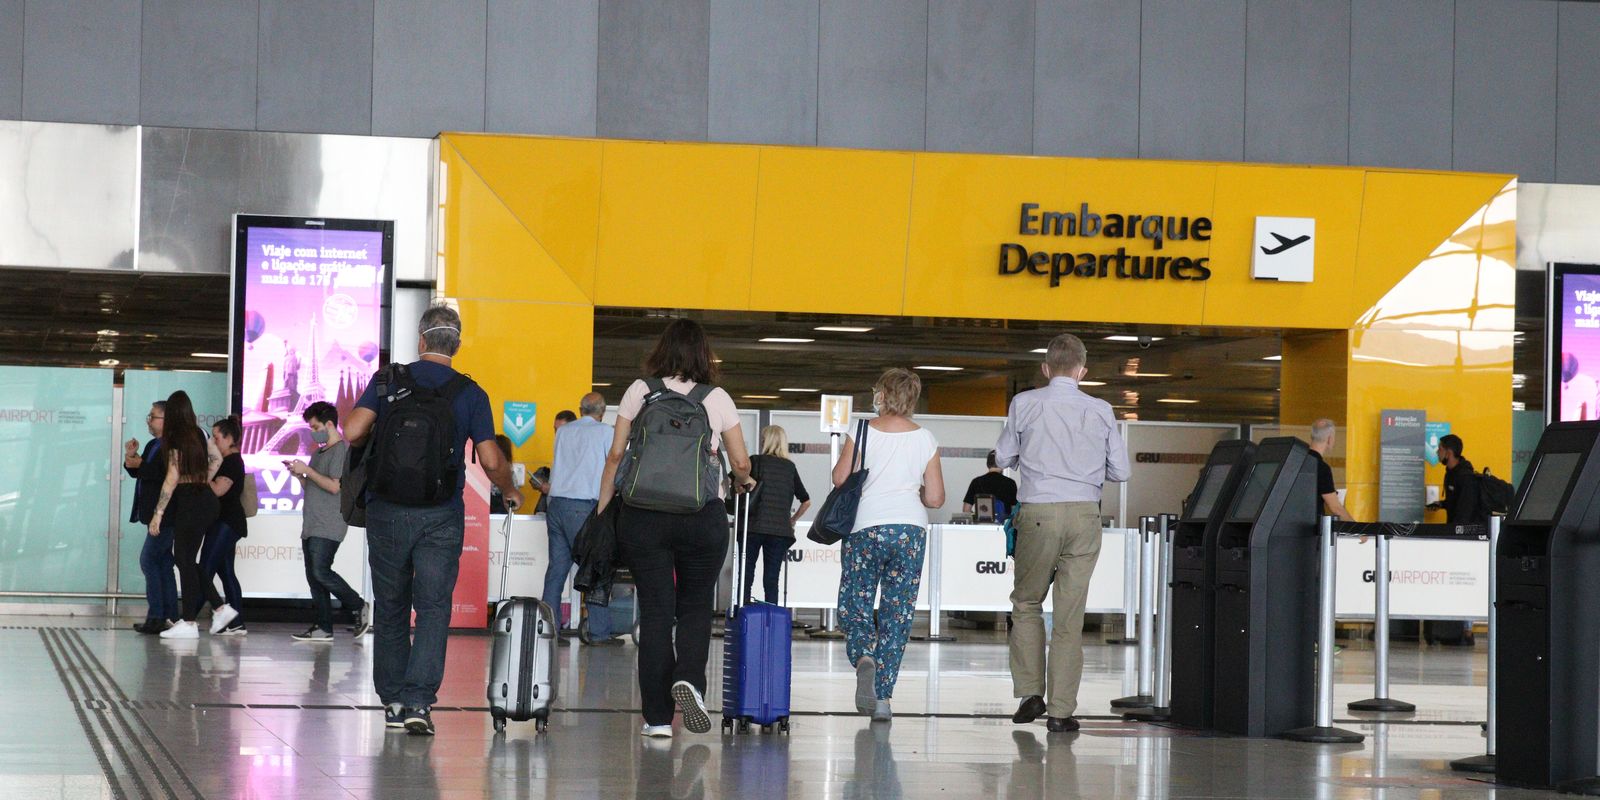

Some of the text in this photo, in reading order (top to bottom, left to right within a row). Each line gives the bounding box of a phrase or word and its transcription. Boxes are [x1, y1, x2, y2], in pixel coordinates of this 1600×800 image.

[1019, 202, 1212, 251] Embarque
[261, 244, 368, 260] Viaje com internet
[261, 260, 270, 270] e
[271, 259, 317, 274] ligações
[998, 242, 1212, 288] Departures
[261, 272, 289, 284] mais
[291, 272, 306, 285] de
[1583, 303, 1600, 317] lig
[235, 545, 295, 561] AIRPORT
